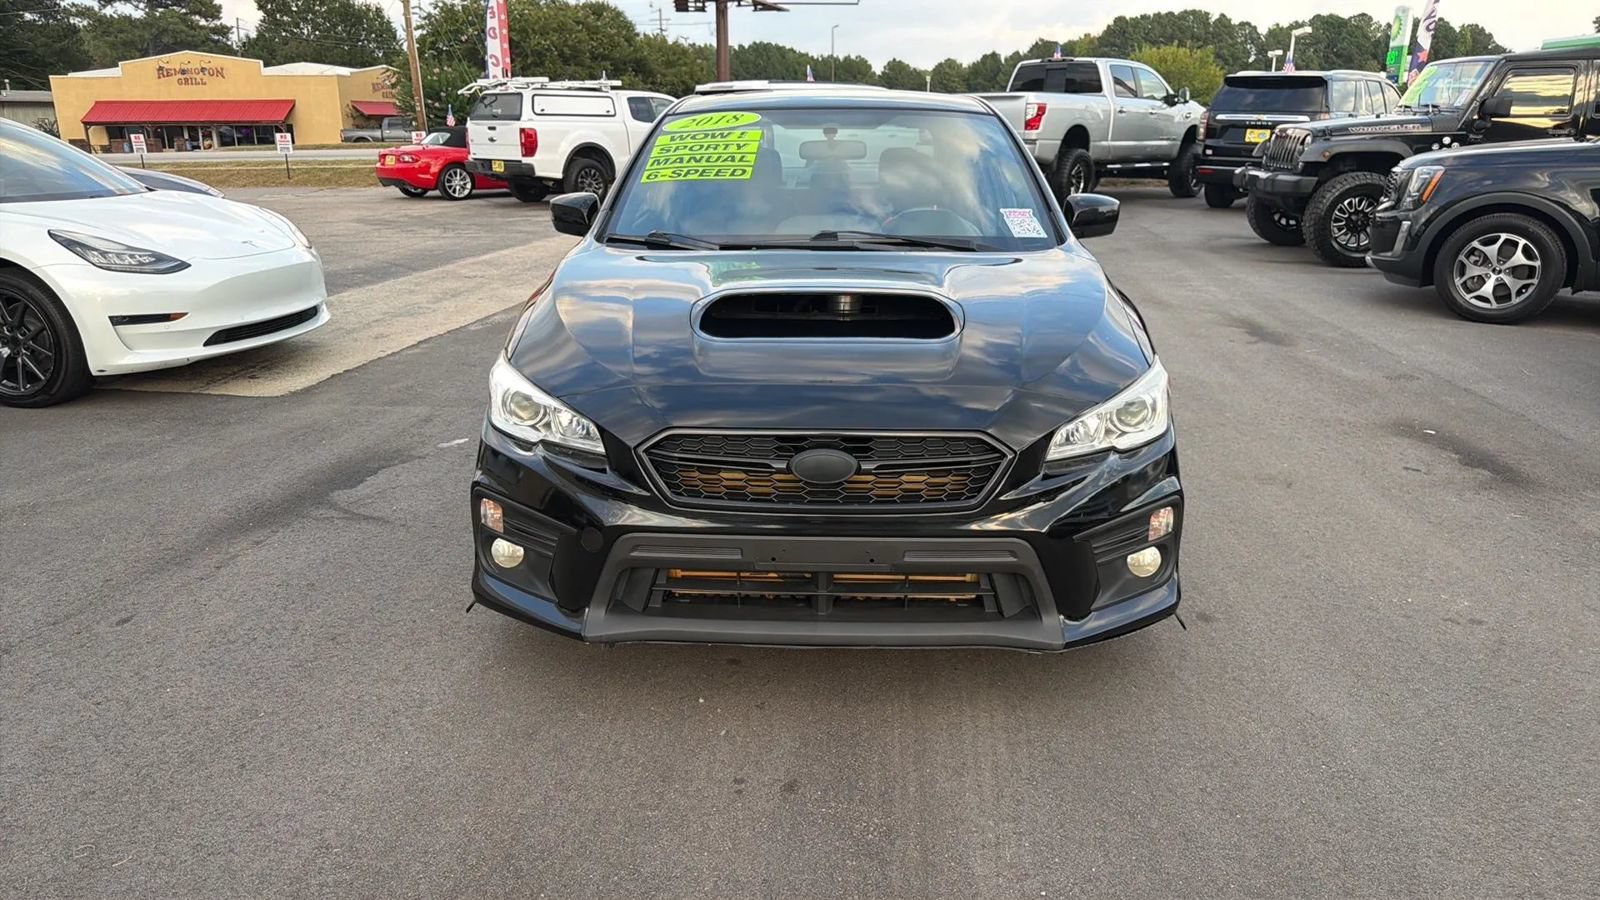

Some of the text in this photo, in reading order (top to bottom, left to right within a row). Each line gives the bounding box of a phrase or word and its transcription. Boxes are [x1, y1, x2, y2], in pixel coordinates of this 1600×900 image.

[177, 77, 207, 86] GRILL
[679, 114, 745, 129] 2018
[1348, 124, 1421, 133] WRANGLER
[669, 131, 732, 142] WOW
[657, 143, 748, 154] SPORTY
[650, 155, 752, 167] MANUAL
[646, 168, 747, 180] 6-SPEED
